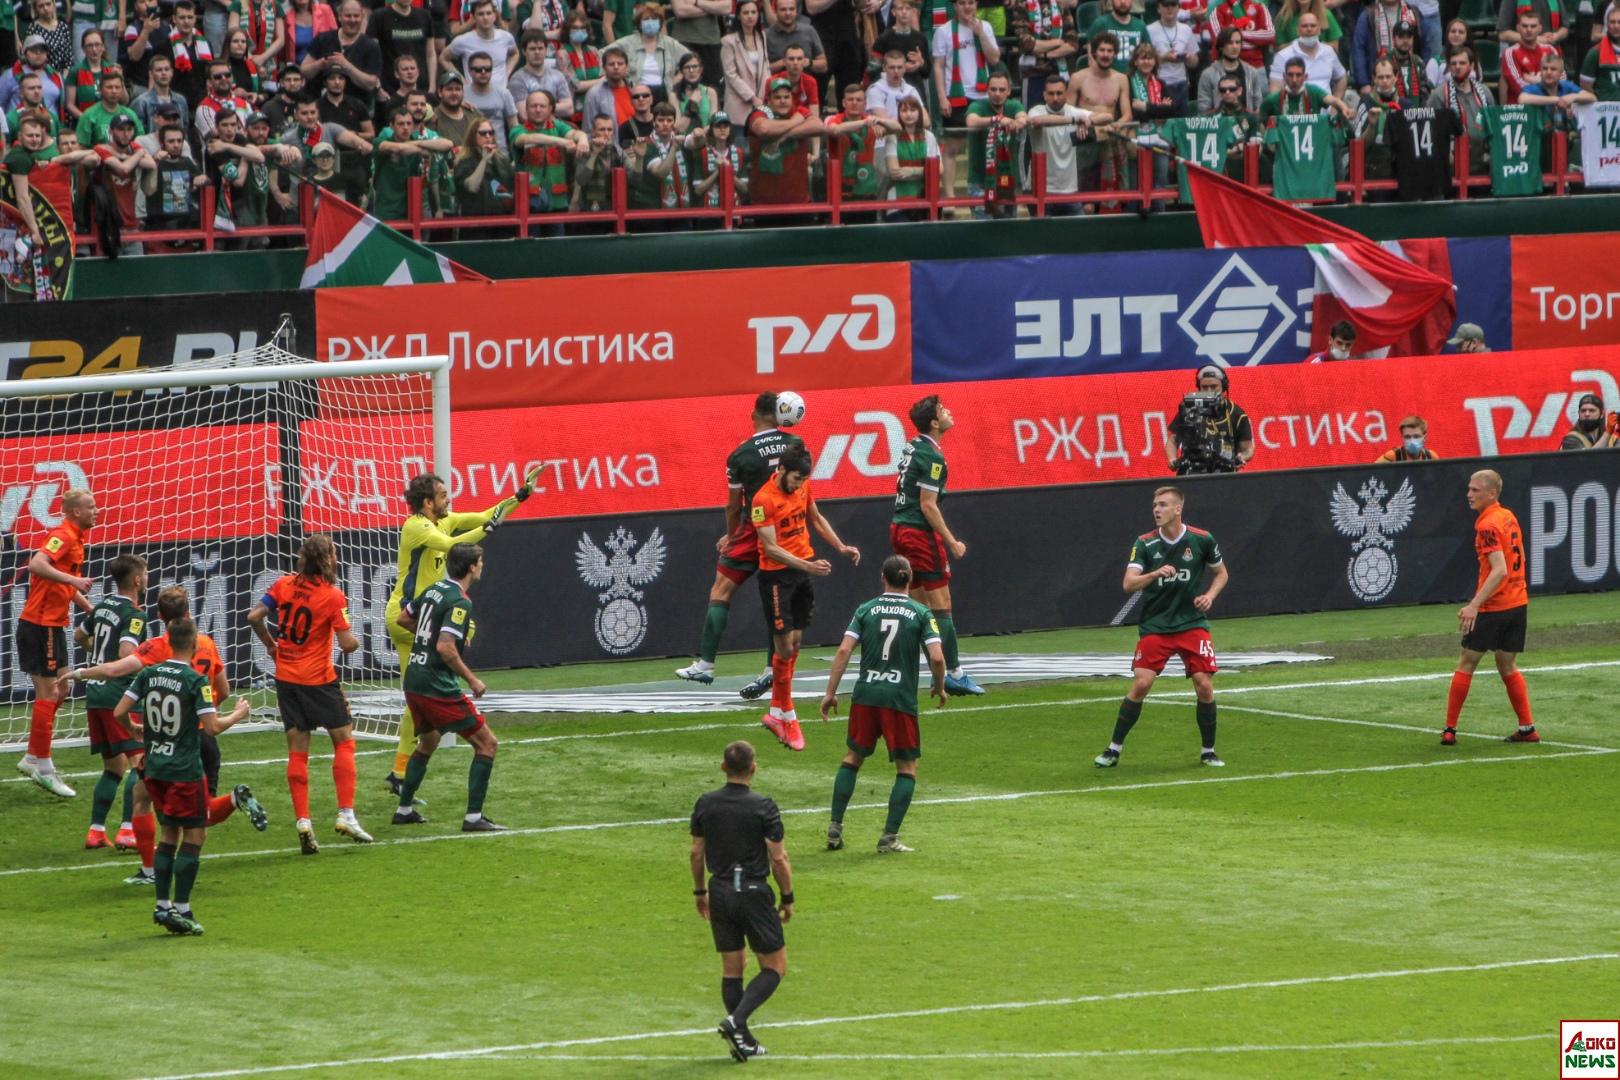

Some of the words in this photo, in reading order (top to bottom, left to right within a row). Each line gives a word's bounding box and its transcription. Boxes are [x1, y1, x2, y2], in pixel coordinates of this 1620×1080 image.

[1186, 132, 1220, 168] 14
[1291, 125, 1314, 161] 14
[1409, 120, 1434, 158] 14
[1501, 123, 1528, 158] 14
[1598, 115, 1620, 149] 14
[327, 333, 432, 380] РЖД
[448, 331, 675, 371] Логистика
[1013, 413, 1129, 469] РЖД
[1141, 410, 1388, 457] Лстика
[1530, 482, 1620, 586] РО
[277, 601, 312, 646] 10
[414, 602, 433, 646] 14
[870, 605, 917, 620] КРЫХОВЯК
[91, 621, 112, 667] 17
[880, 619, 900, 660] 7
[1200, 639, 1214, 658] 45
[149, 676, 182, 693] КУЛИКОВ
[145, 690, 181, 737] 69
